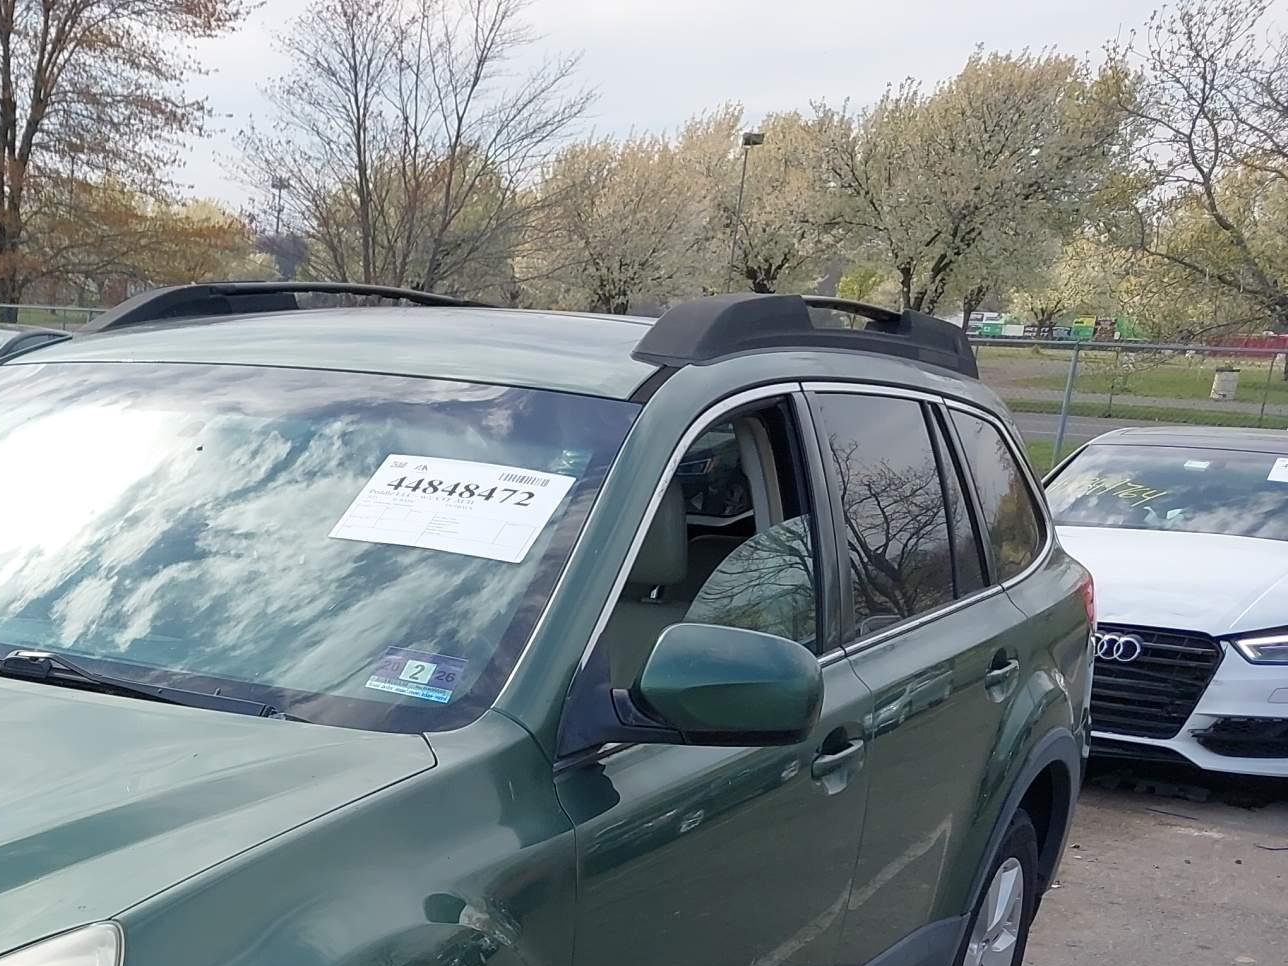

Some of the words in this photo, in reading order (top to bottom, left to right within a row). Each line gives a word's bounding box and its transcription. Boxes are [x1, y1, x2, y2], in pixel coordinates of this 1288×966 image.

[386, 474, 535, 507] 44848472
[408, 663, 426, 681] 2
[434, 670, 457, 683] 26
